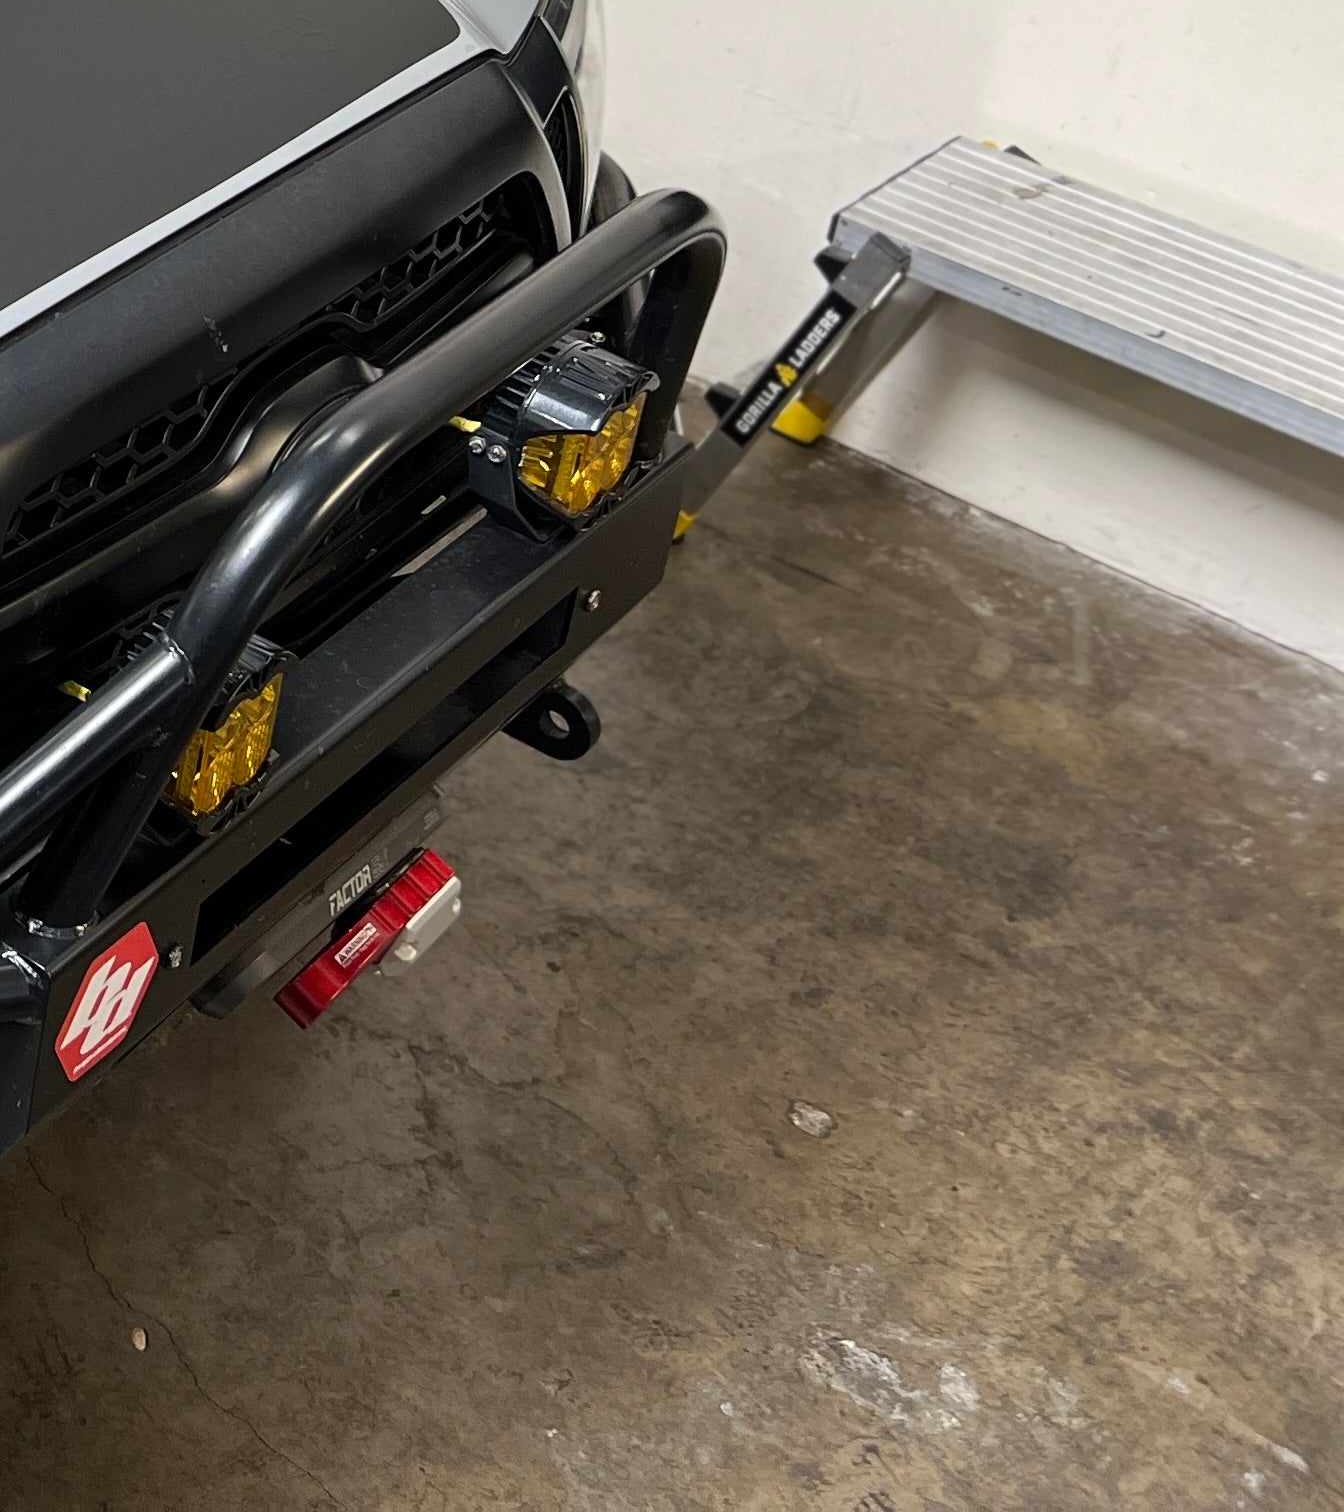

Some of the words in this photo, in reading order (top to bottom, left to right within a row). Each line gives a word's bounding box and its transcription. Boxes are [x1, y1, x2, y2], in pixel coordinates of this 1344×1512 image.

[735, 380, 782, 435] GORILLA
[788, 307, 841, 368] LADDERS
[328, 863, 372, 917] FACTOR
